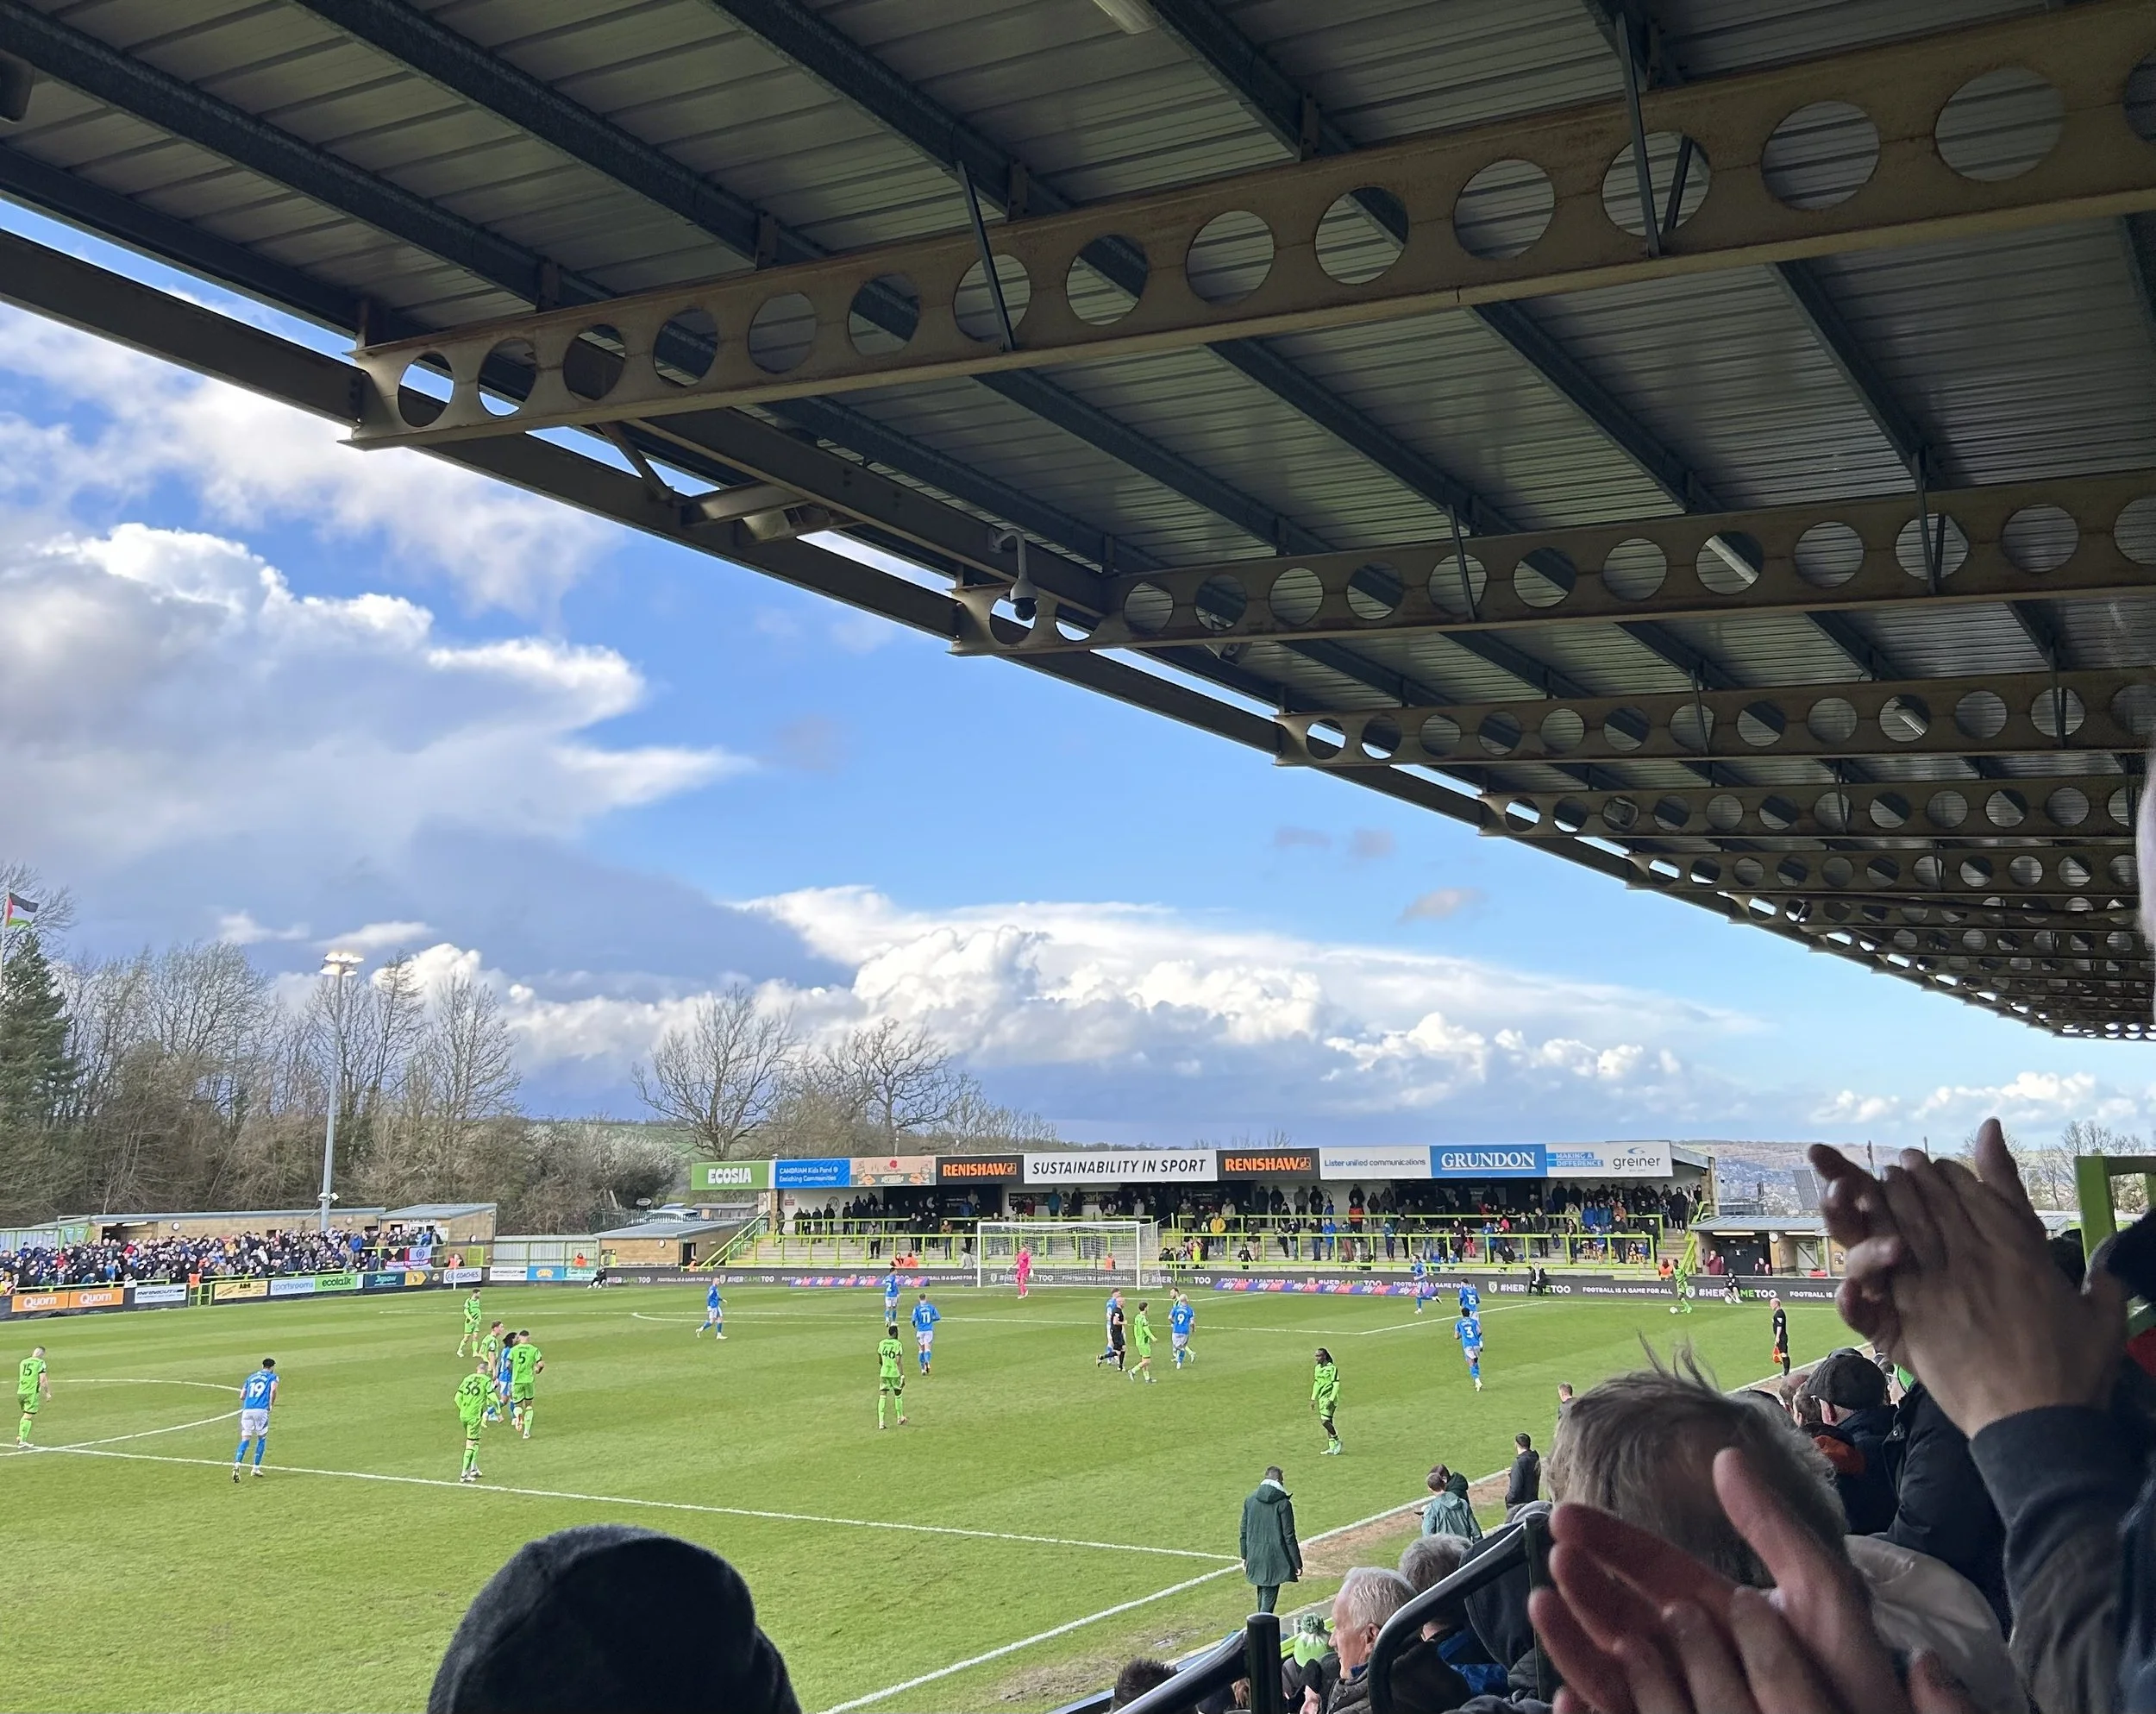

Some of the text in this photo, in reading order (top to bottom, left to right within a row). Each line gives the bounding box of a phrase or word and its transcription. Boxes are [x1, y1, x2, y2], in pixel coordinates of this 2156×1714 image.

[1225, 1158, 1299, 1171] RENISHAW
[1369, 1158, 1426, 1166] communications
[1441, 1152, 1535, 1167] GRUNDON
[1613, 1158, 1661, 1170] greiner
[943, 1164, 1006, 1177] RENISHAW
[1032, 1158, 1206, 1175] SUSTAINABILITY IN SPORT
[707, 1168, 752, 1184] ECOSIA
[273, 1283, 313, 1291] sportsrooms
[1699, 1288, 1777, 1297] #HERMETOO
[23, 1295, 57, 1309] Quorn
[80, 1293, 113, 1305] Quorn
[922, 1312, 931, 1323] 11
[1177, 1313, 1185, 1324] 9
[1464, 1328, 1474, 1339] 3
[518, 1351, 526, 1365] 5
[882, 1347, 896, 1359] 46
[23, 1364, 33, 1376] 15
[248, 1381, 266, 1397] 19
